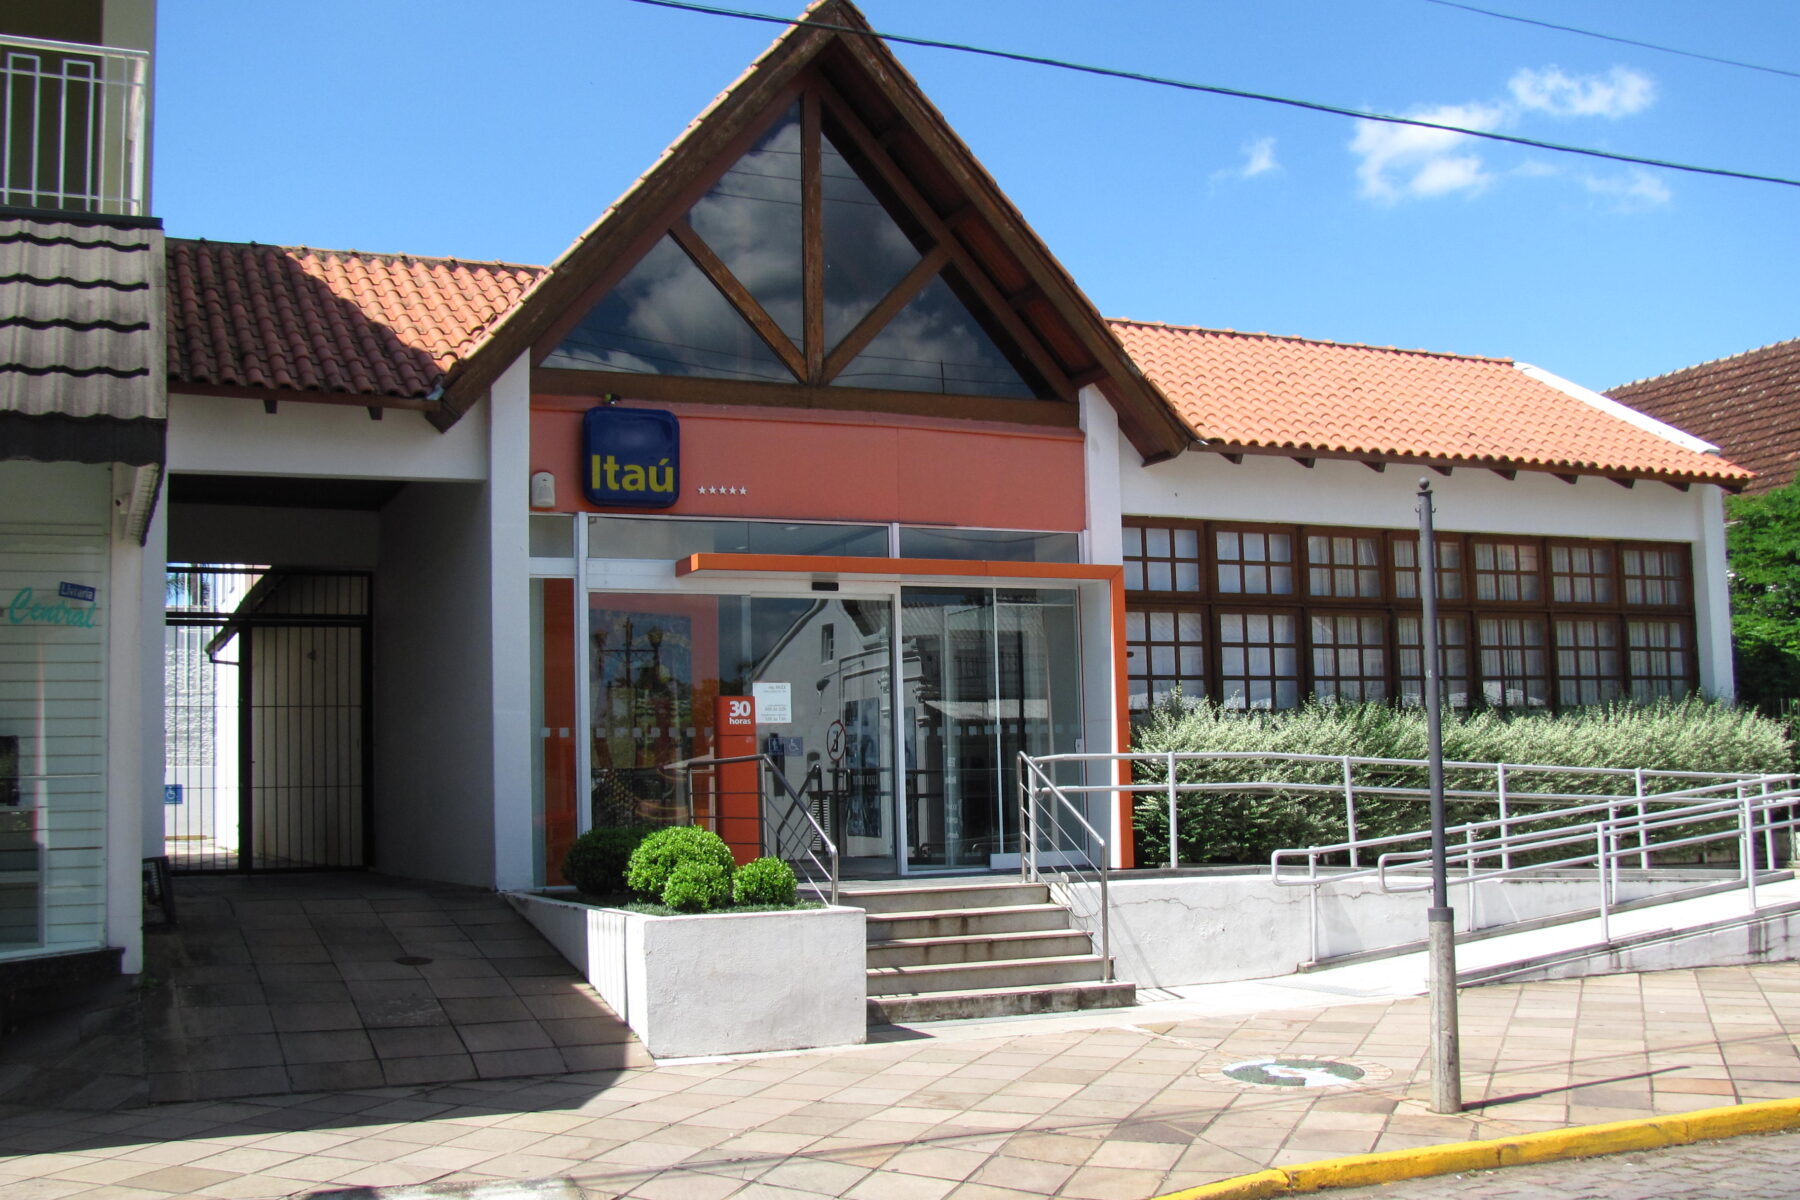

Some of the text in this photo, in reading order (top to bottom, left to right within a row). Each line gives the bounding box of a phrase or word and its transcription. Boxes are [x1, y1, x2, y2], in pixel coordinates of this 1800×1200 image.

[591, 454, 674, 493] Itaú
[9, 587, 97, 628] Central
[729, 700, 751, 717] 30
[729, 717, 752, 725] horas
